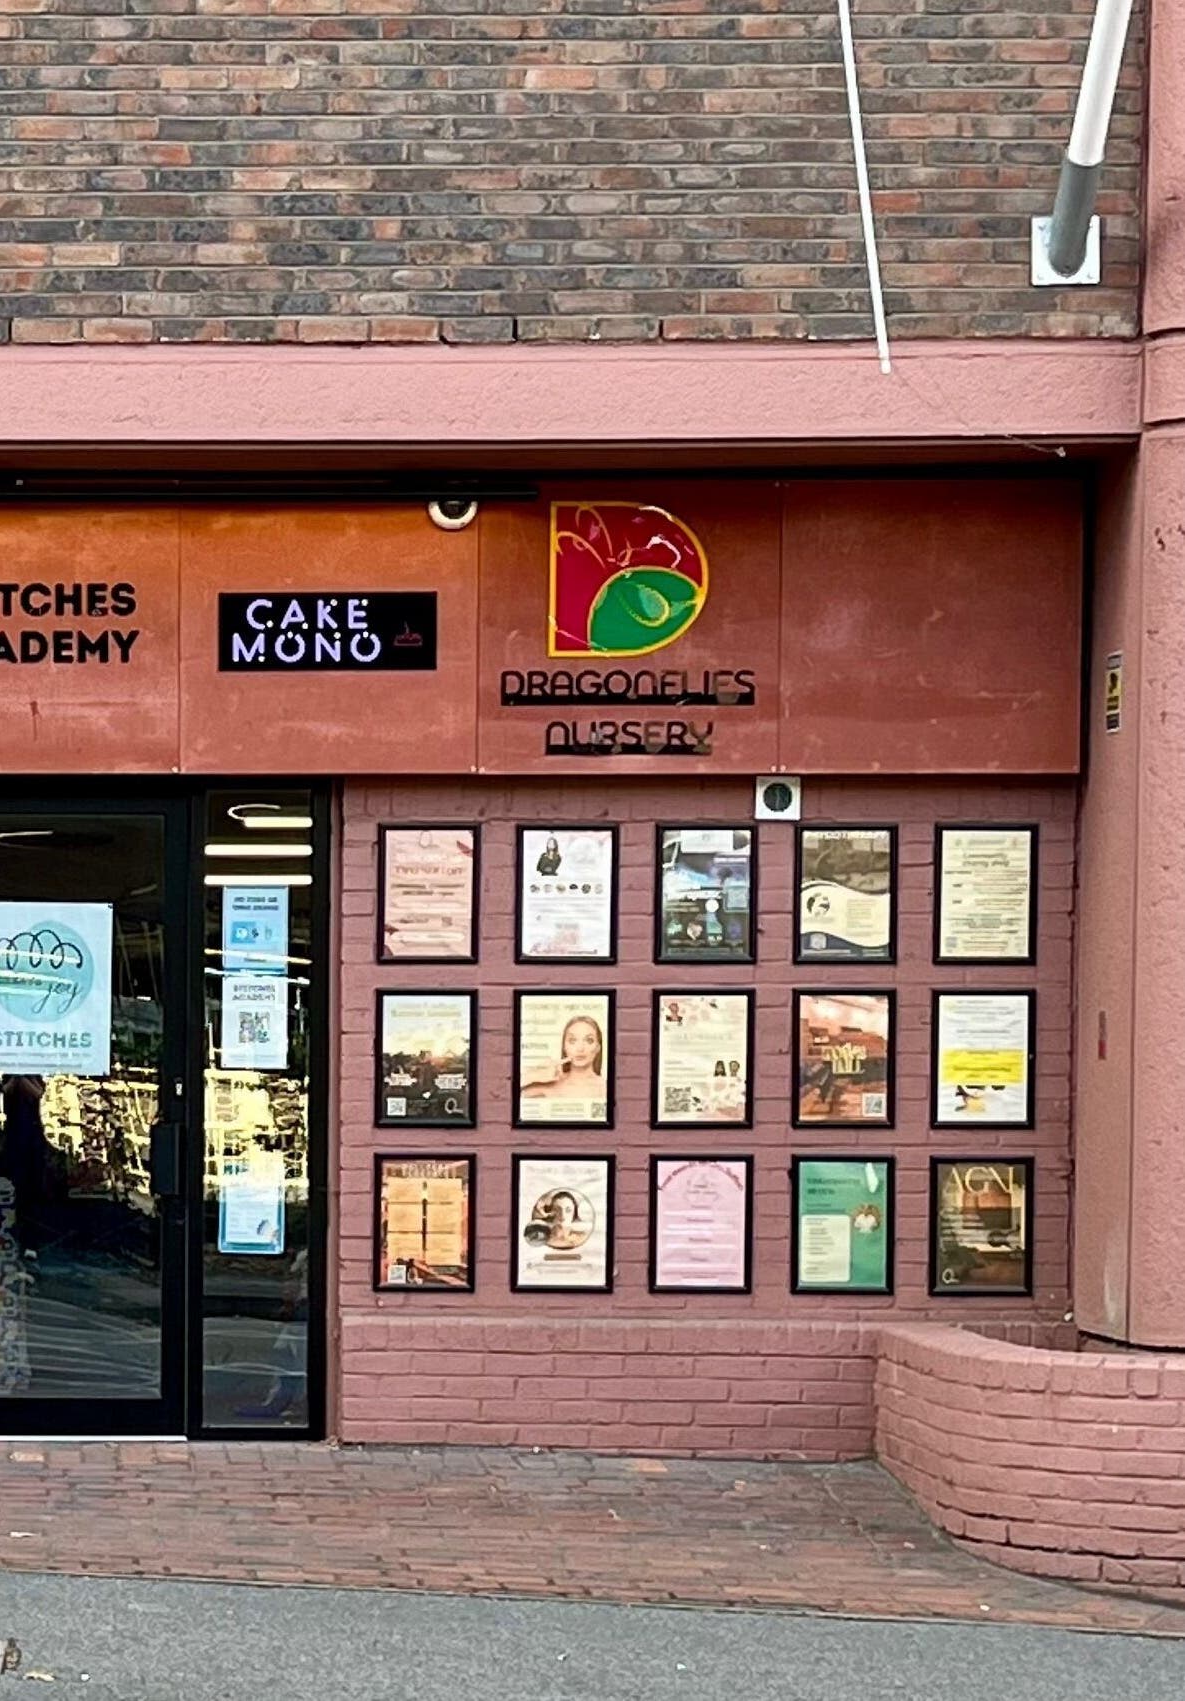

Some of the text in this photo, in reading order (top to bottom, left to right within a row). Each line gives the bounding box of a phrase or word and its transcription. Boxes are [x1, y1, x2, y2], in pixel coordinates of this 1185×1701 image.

[246, 599, 369, 630] CAKE
[232, 631, 381, 662] MONO
[501, 670, 755, 699] DRAGONFLIES
[546, 721, 713, 750] NURSERY
